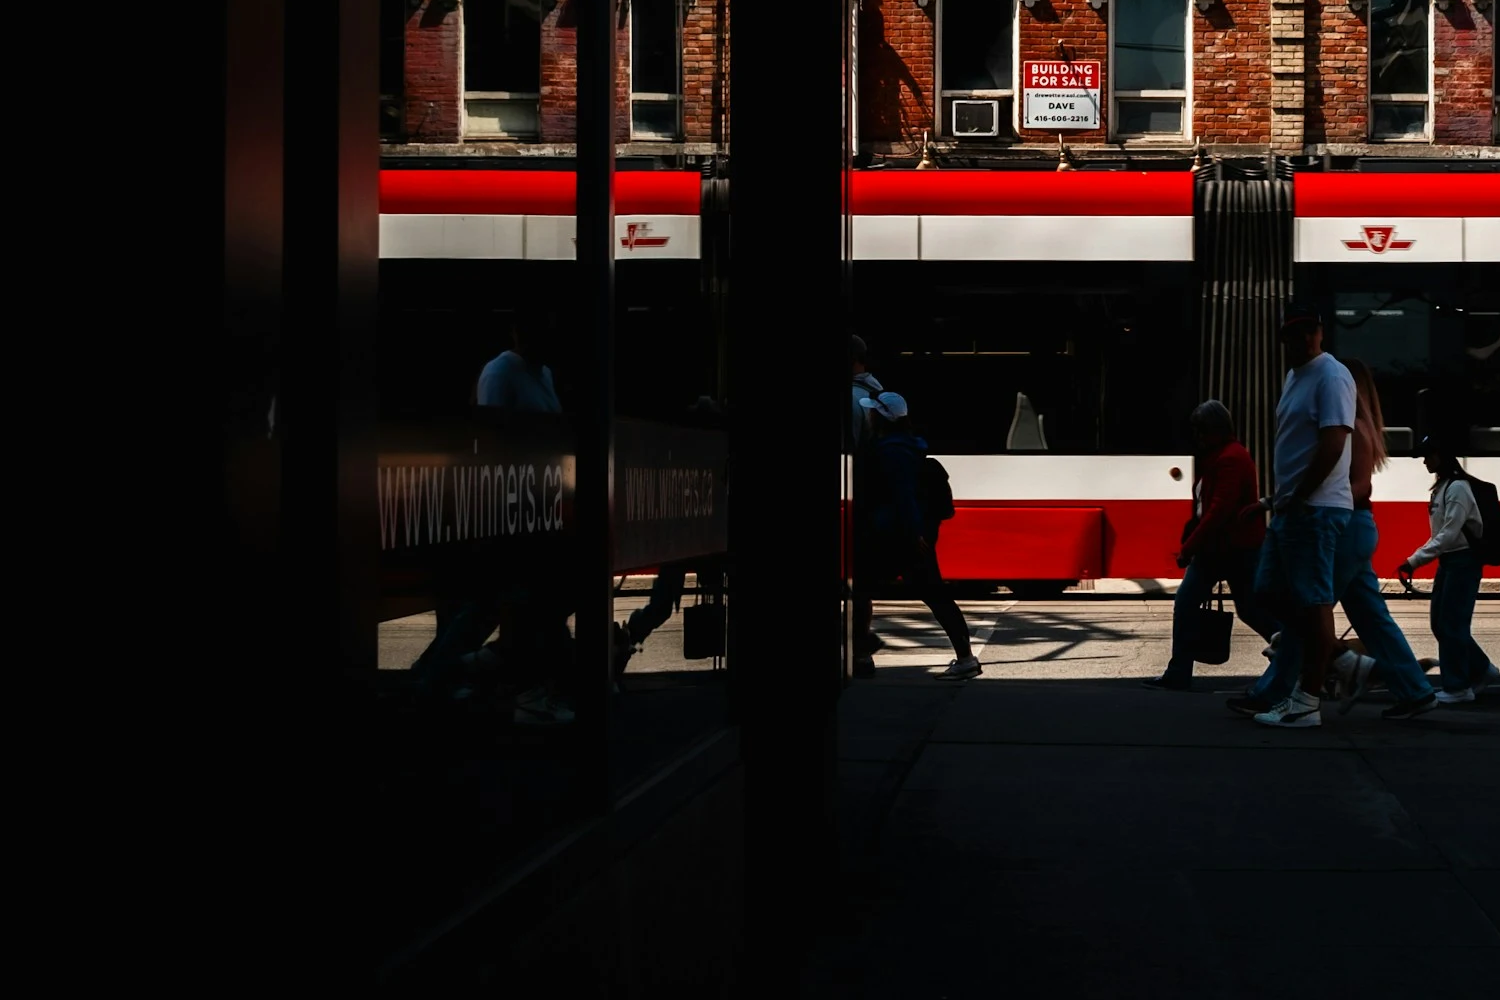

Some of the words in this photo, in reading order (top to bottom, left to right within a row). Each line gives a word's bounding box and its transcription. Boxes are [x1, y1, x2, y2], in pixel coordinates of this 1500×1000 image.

[1031, 63, 1093, 75] BUILDING
[1031, 75, 1058, 87] FOR
[1061, 76, 1092, 87] SALE
[1048, 102, 1075, 110] DAVE
[625, 450, 713, 521] www.winners.ca
[377, 438, 563, 551] www.winners.ca
